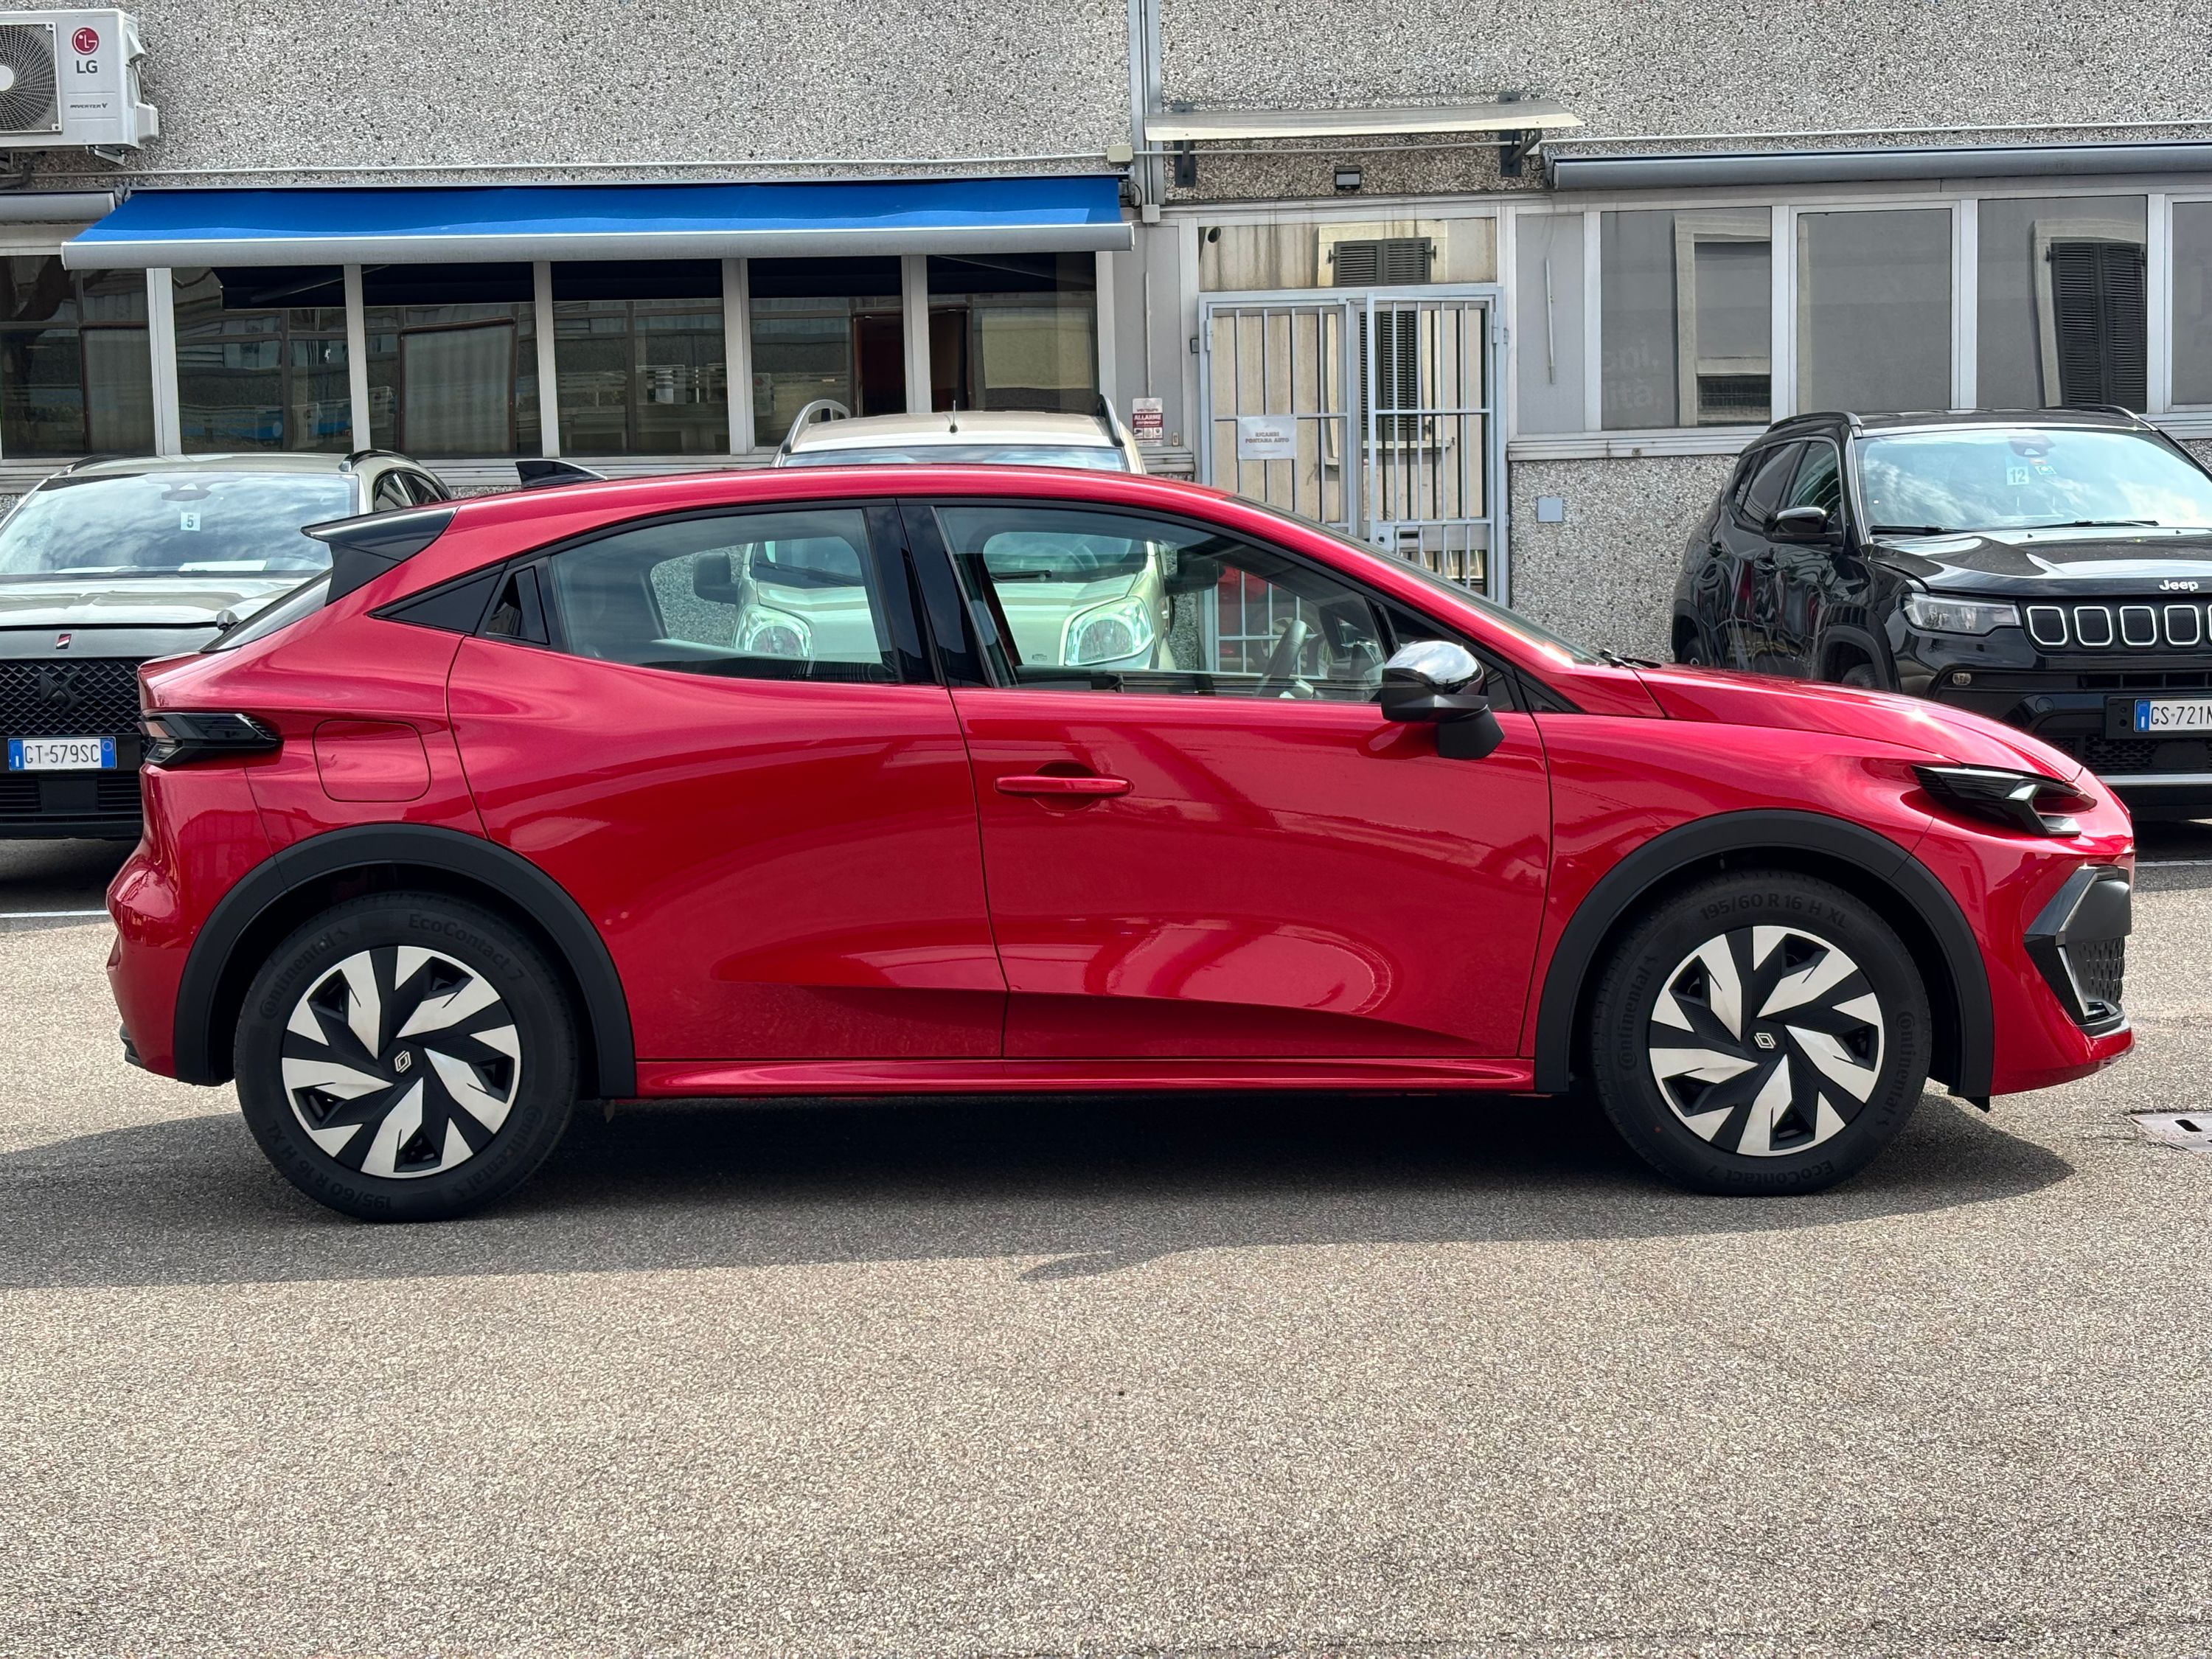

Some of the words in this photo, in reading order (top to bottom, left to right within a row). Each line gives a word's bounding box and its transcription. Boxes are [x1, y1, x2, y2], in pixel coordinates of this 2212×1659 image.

[76, 60, 98, 74] LG
[2010, 469, 2025, 483] 12
[187, 514, 195, 529] 5
[2159, 580, 2199, 591] Jeep
[1700, 893, 1764, 921] 195/60
[1767, 893, 1780, 908] R
[1784, 894, 1804, 910] 16
[1807, 899, 1823, 916] H
[1826, 907, 1848, 928] XL
[407, 913, 510, 971] EcoContact
[507, 970, 526, 983] 7
[260, 933, 337, 1020] Continental
[1618, 961, 1654, 1071] Continental
[1882, 1010, 1916, 1119] Continental
